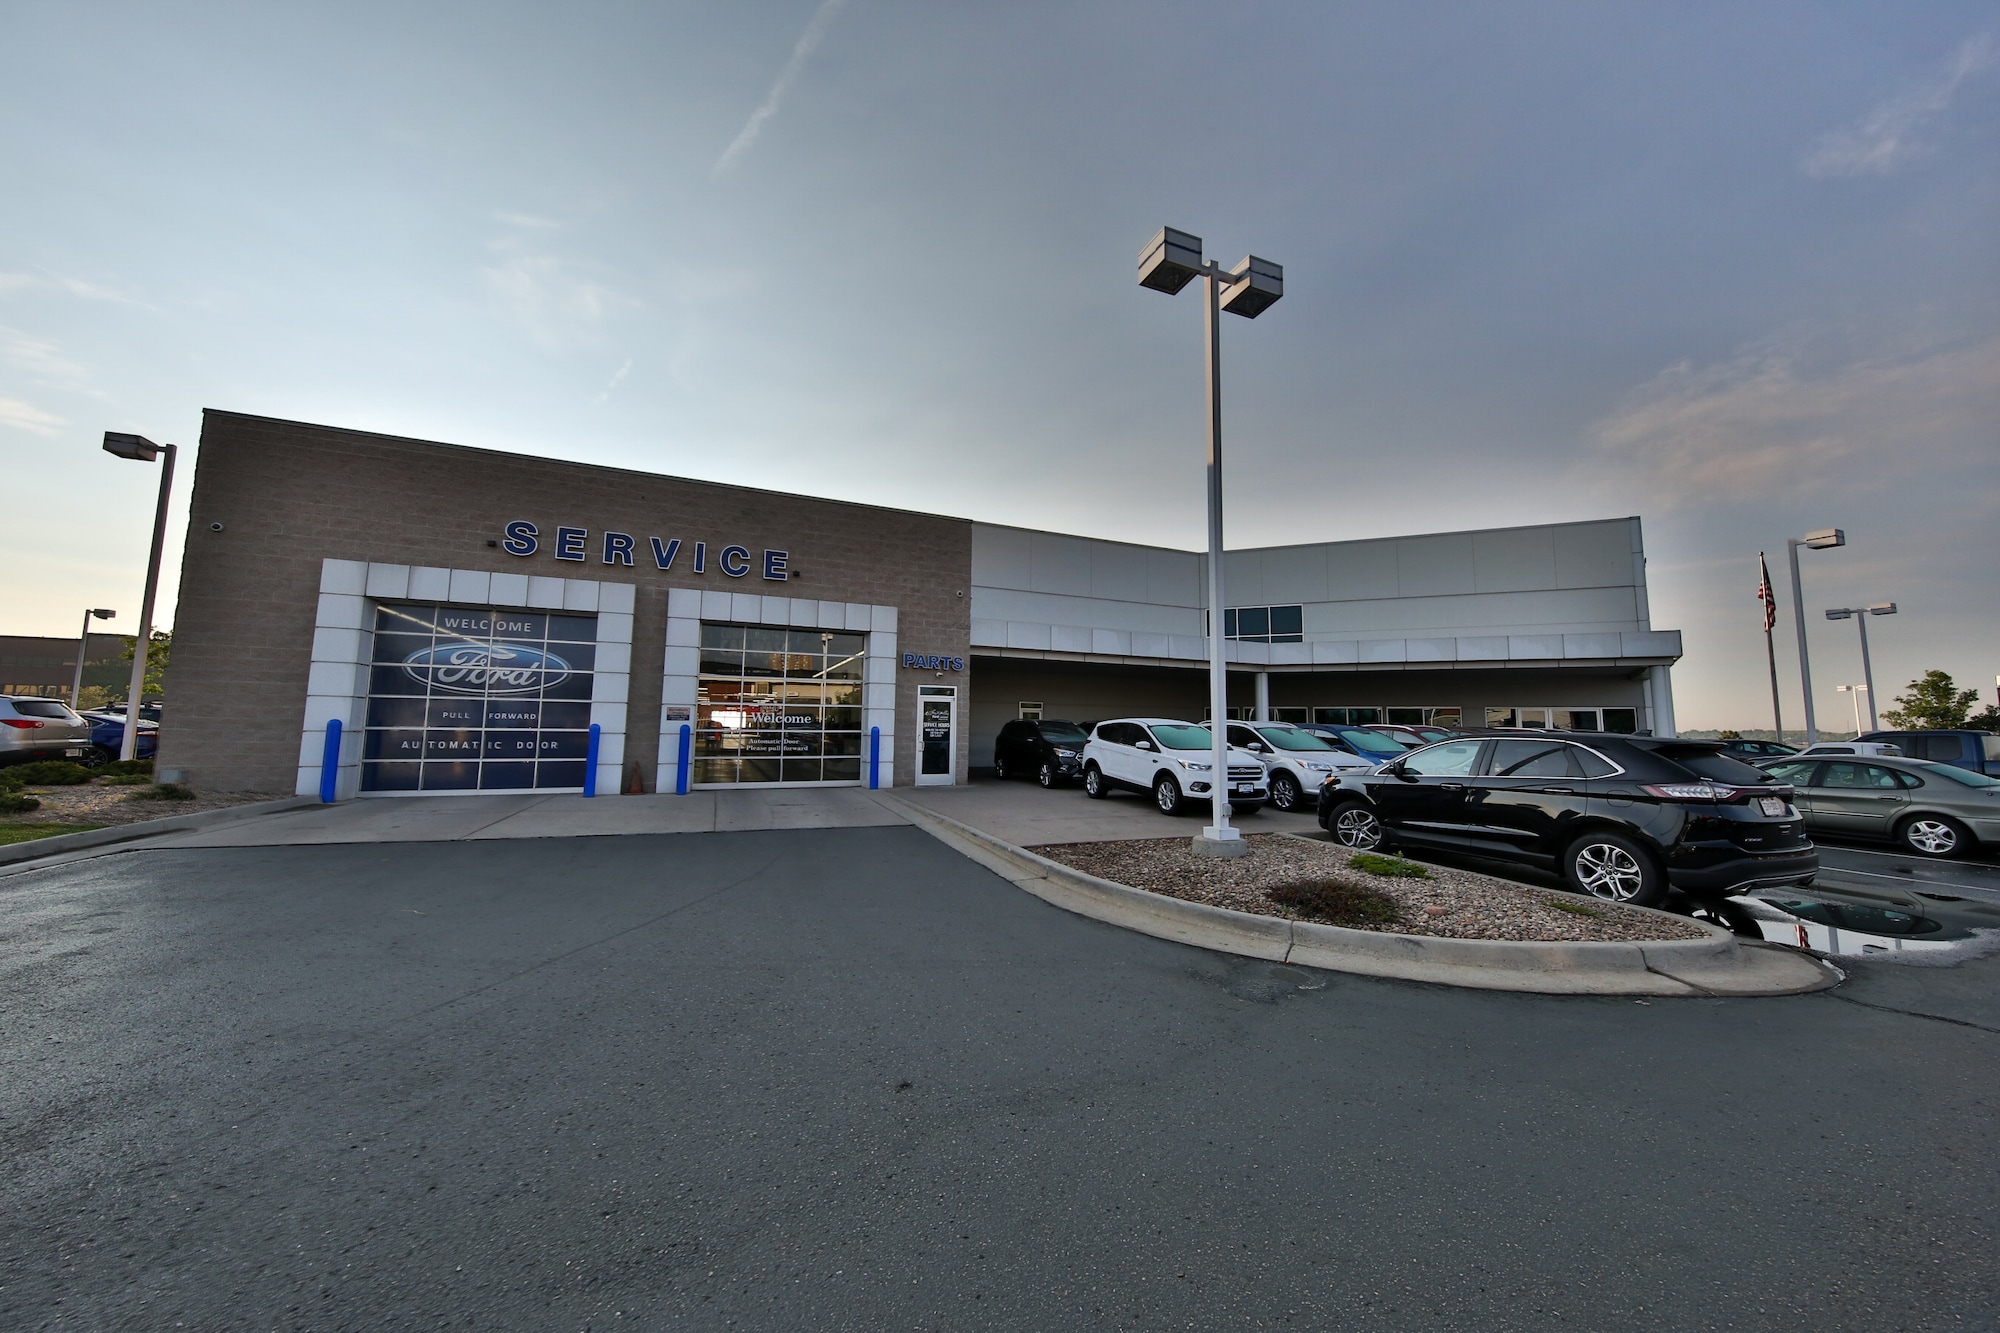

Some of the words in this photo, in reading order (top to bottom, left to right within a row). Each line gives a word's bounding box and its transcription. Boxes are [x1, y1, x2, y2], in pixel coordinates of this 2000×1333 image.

[502, 519, 789, 581] SERVICE
[444, 617, 532, 633] WELCOME
[437, 649, 541, 686] Ford
[902, 652, 965, 671] PARTS
[442, 711, 471, 719] PULL
[488, 712, 537, 720] FORWARD
[750, 712, 812, 724] Welcome
[401, 740, 502, 750] AUTOMATIC
[516, 741, 559, 750] DOOR
